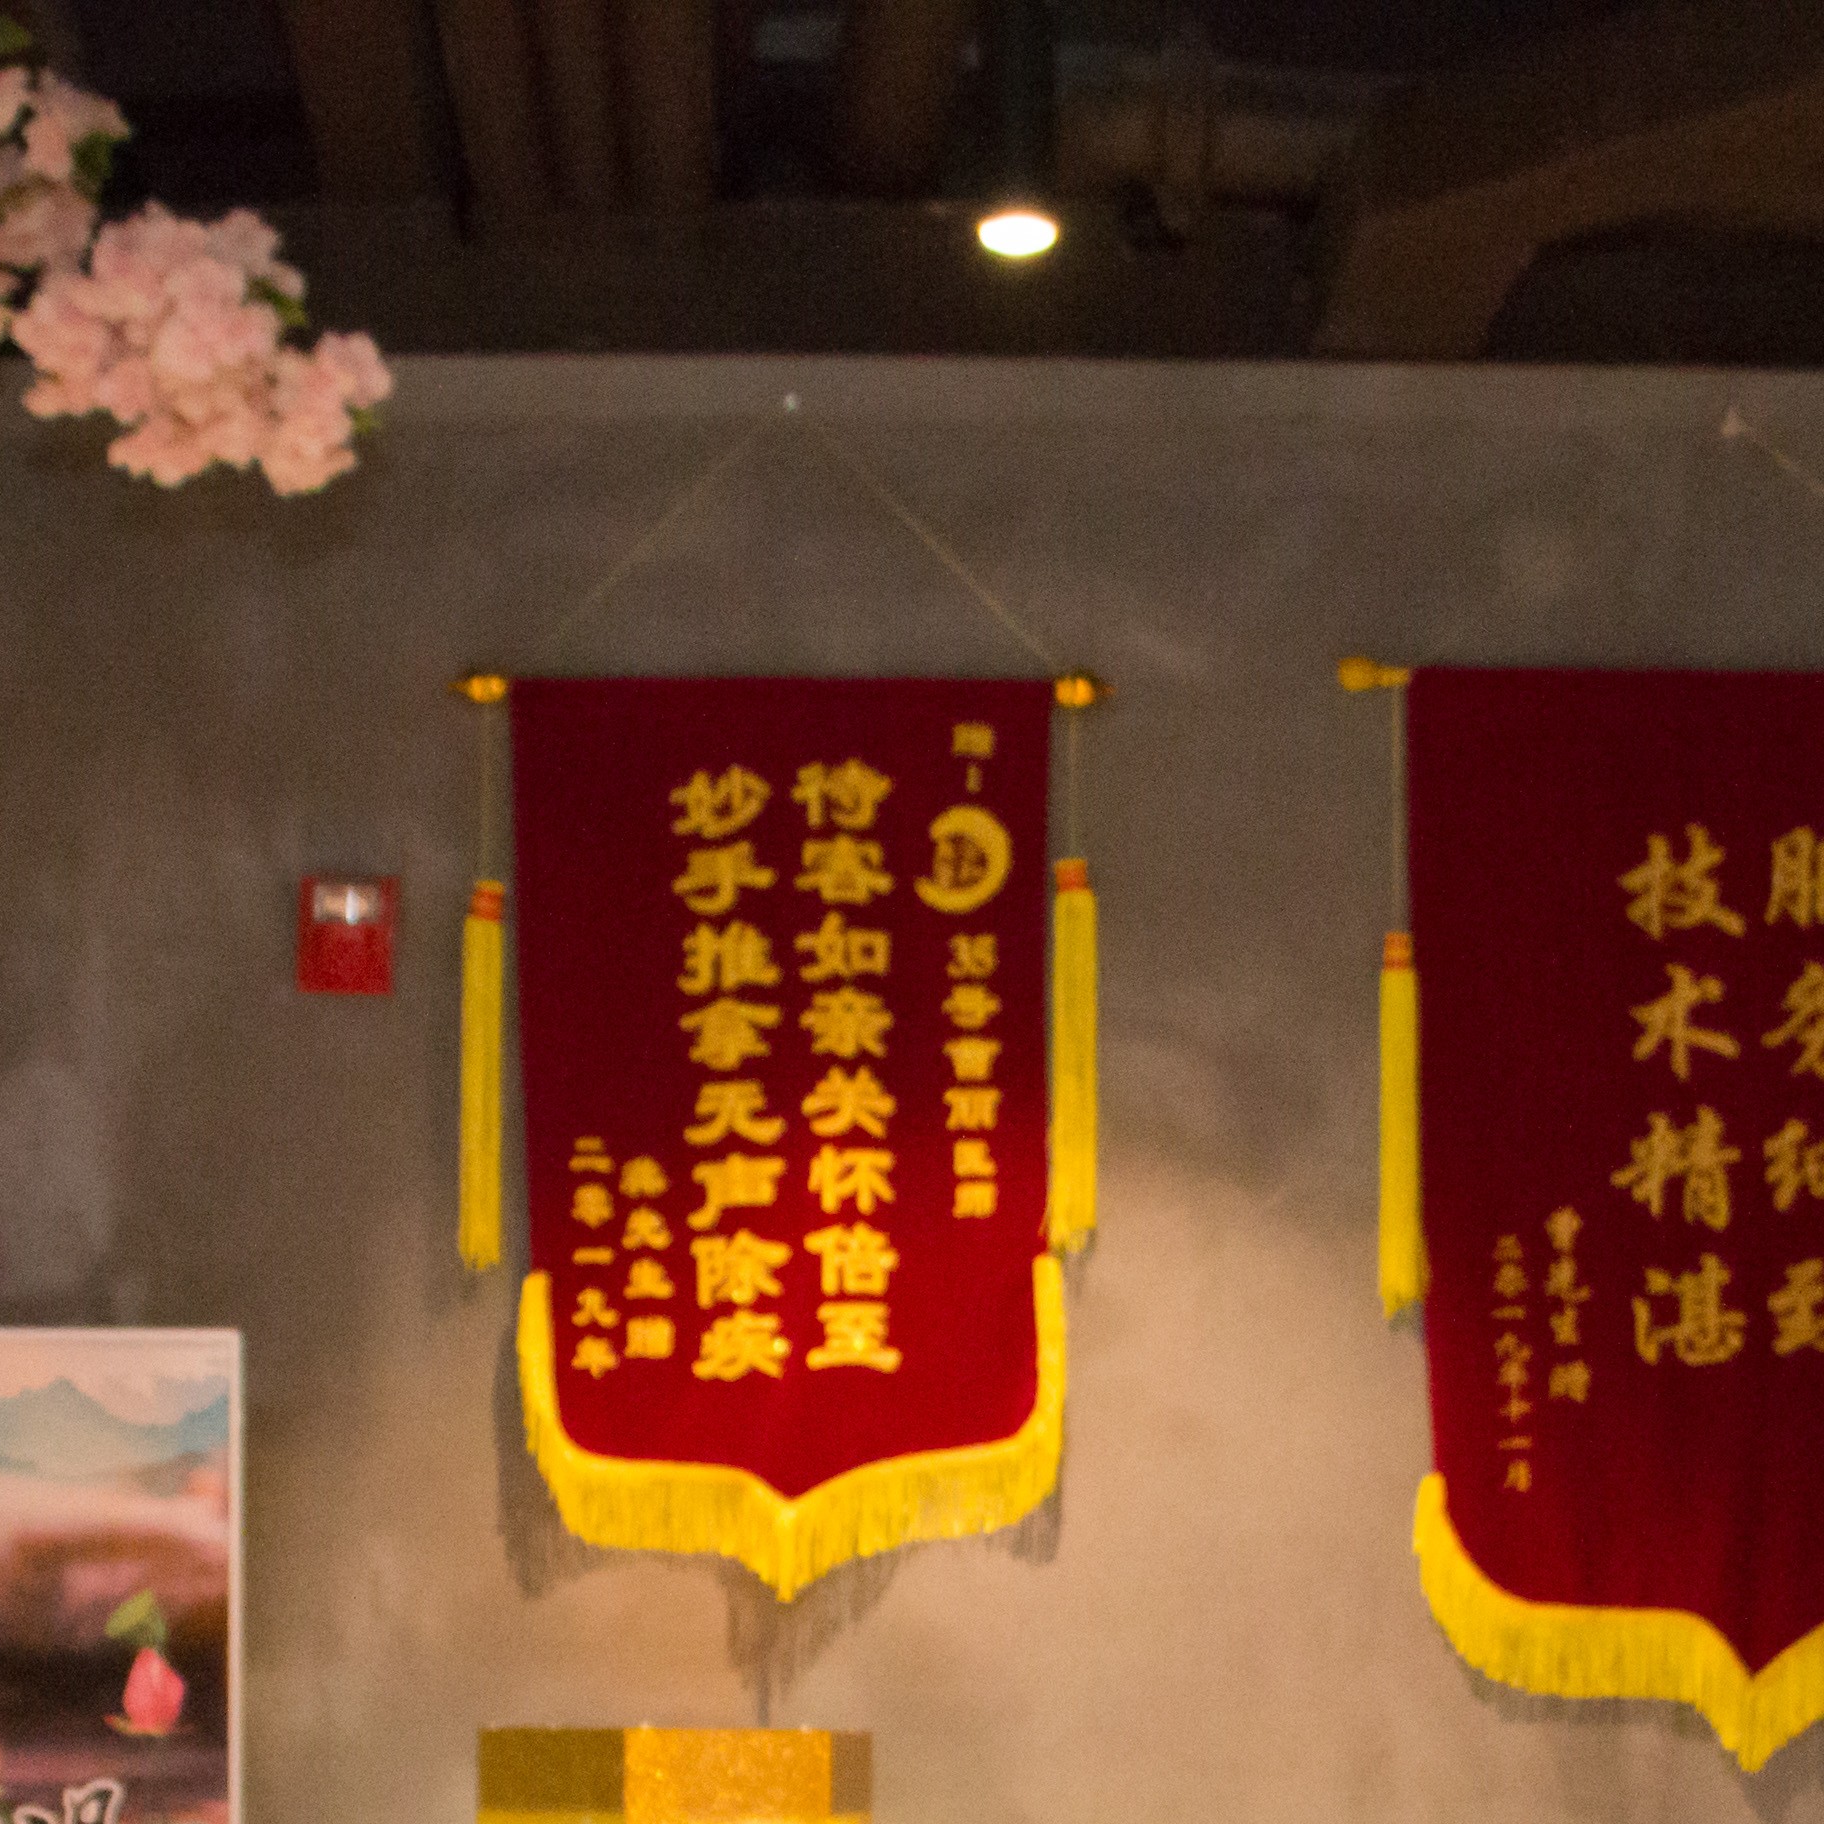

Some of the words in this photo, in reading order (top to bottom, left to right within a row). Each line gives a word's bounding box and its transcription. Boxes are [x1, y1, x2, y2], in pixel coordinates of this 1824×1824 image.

[668, 763, 793, 1382] 妙手推拿无声除疾
[790, 757, 905, 1376] 待客如亲关怀倍至
[1610, 822, 1747, 1367] 技术精湛
